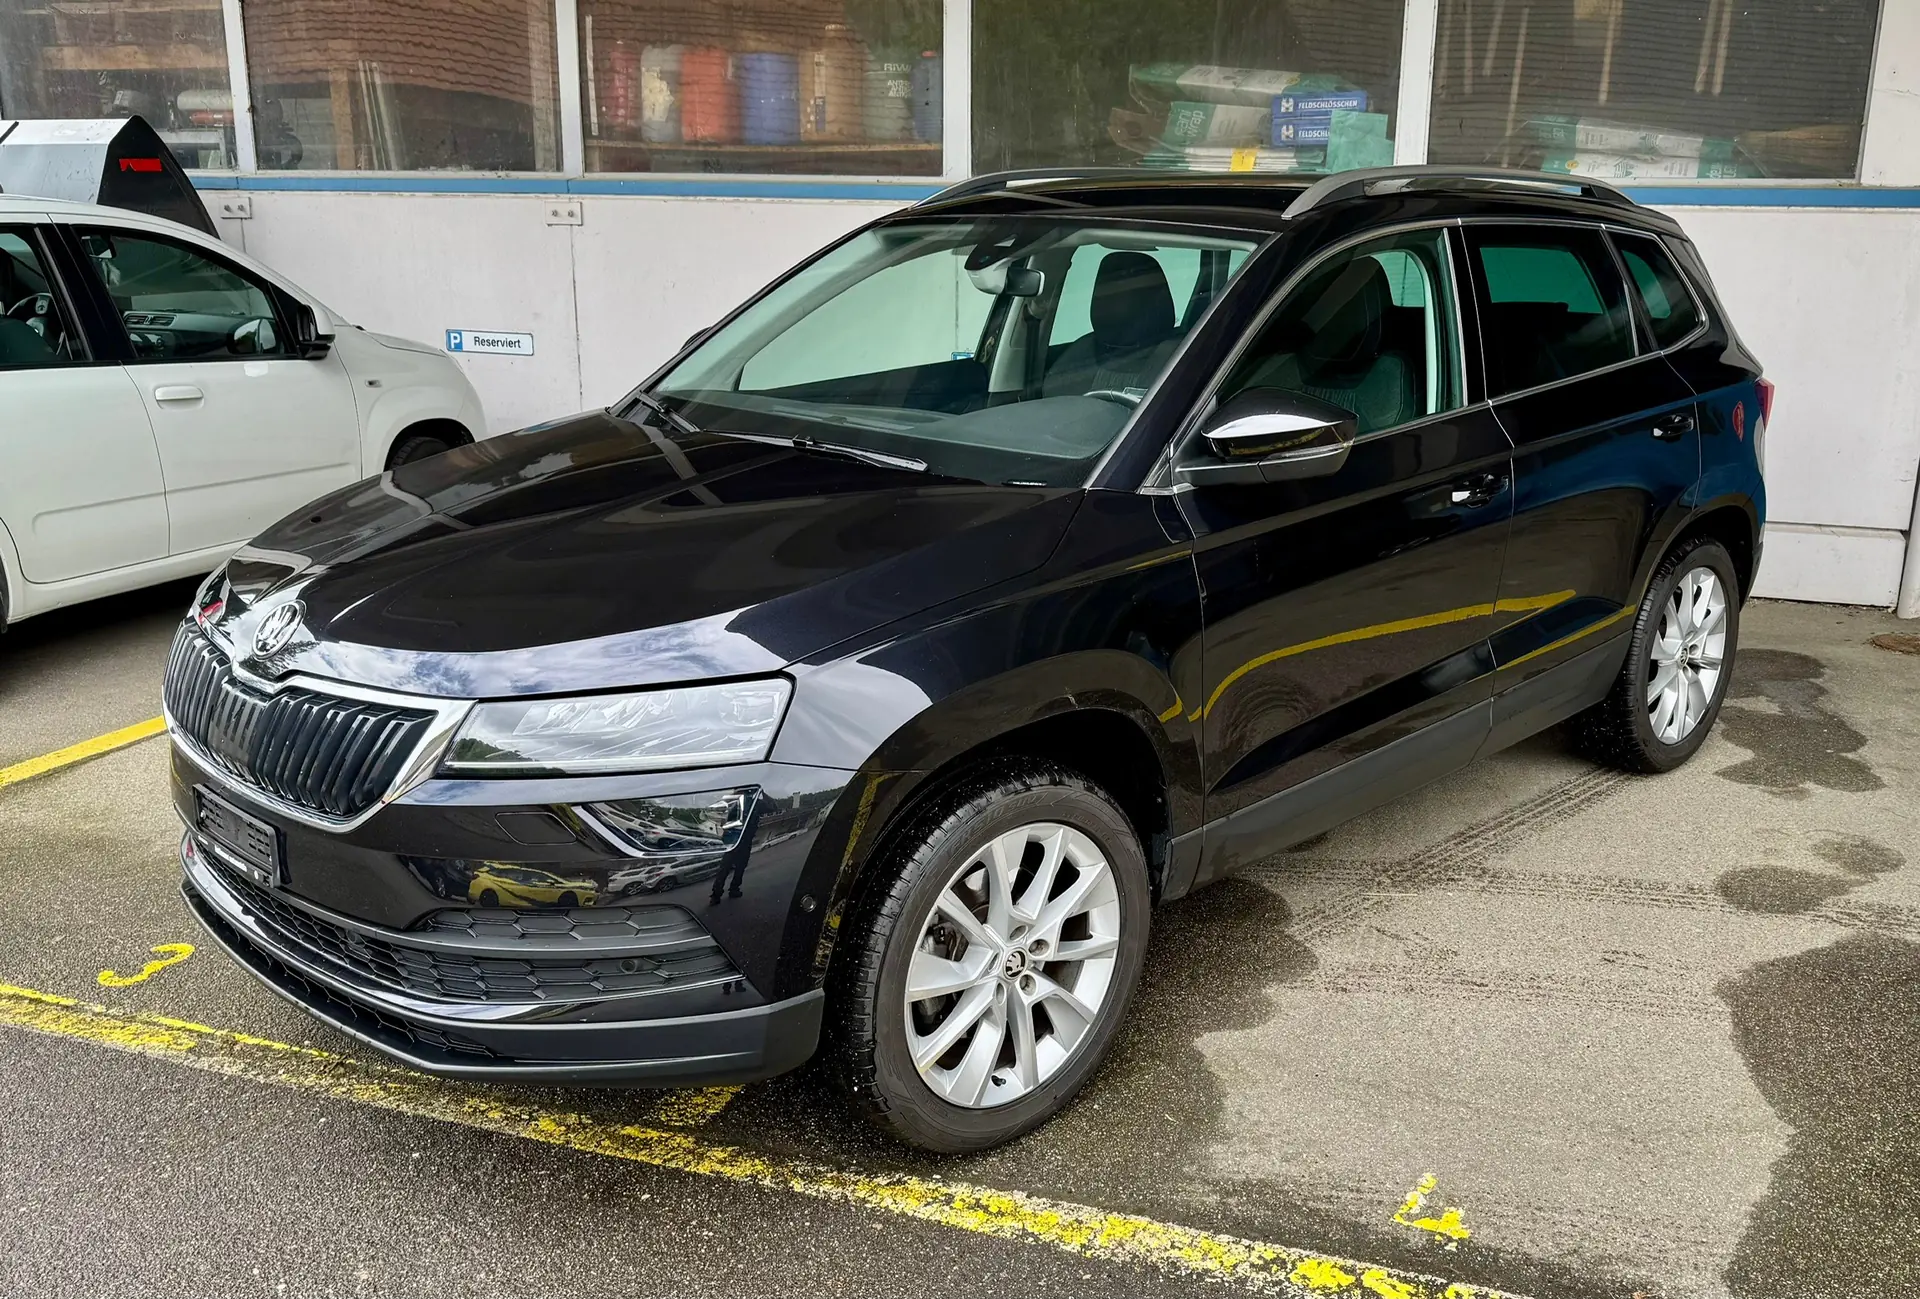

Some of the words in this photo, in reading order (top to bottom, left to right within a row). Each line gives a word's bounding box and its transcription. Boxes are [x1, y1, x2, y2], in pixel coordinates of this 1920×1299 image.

[1298, 100, 1358, 109] FELDSCHLÖSSCHEN
[1298, 130, 1330, 138] FELDSCHL
[450, 333, 460, 349] P
[474, 336, 521, 348] Reserviert
